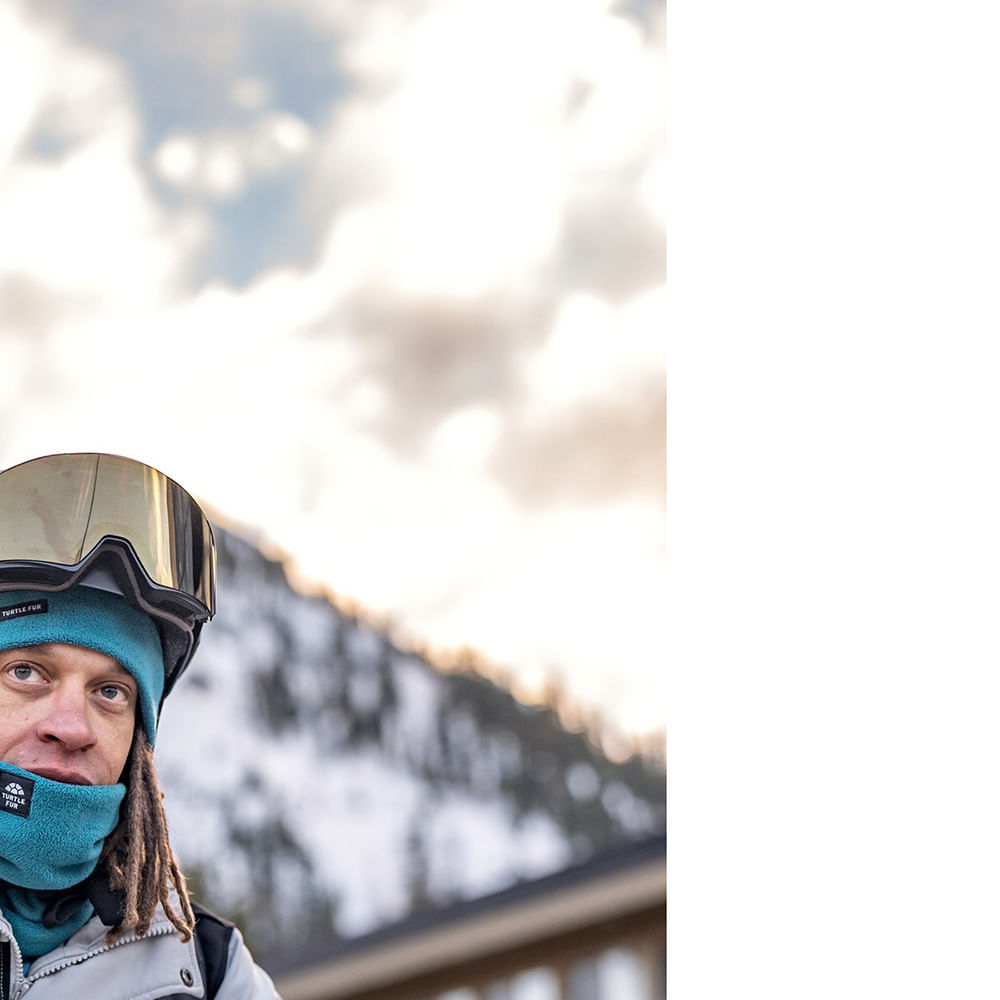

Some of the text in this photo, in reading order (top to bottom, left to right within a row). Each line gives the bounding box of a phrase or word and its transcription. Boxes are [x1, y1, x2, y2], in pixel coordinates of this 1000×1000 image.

[2, 604, 42, 617] TURTLE FUR
[1, 791, 26, 805] TURTLE
[5, 800, 19, 810] FUR
